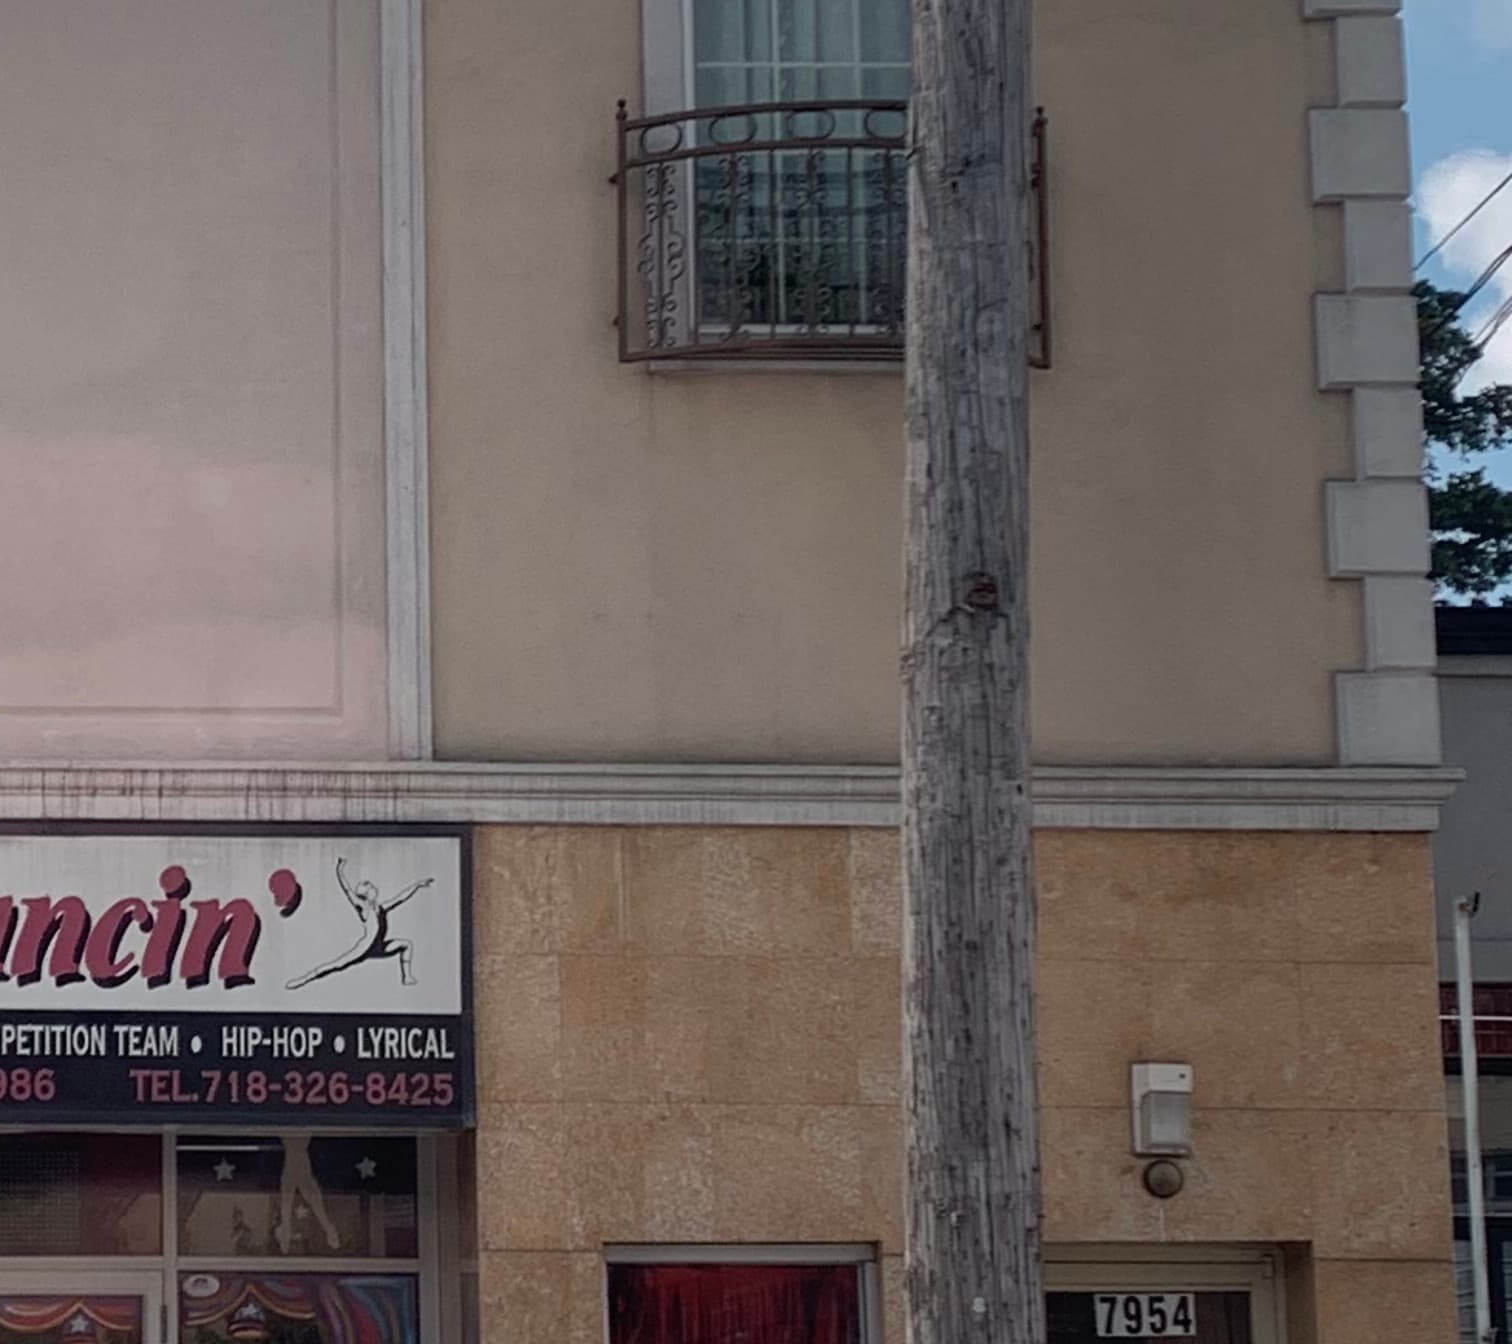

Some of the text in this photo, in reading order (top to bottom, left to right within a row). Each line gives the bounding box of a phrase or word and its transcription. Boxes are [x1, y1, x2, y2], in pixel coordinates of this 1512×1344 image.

[113, 1025, 179, 1056] TEAM
[221, 1027, 323, 1057] HIP-HOP
[357, 1027, 455, 1059] LYRICAL
[1098, 1295, 1192, 1334] 7954
